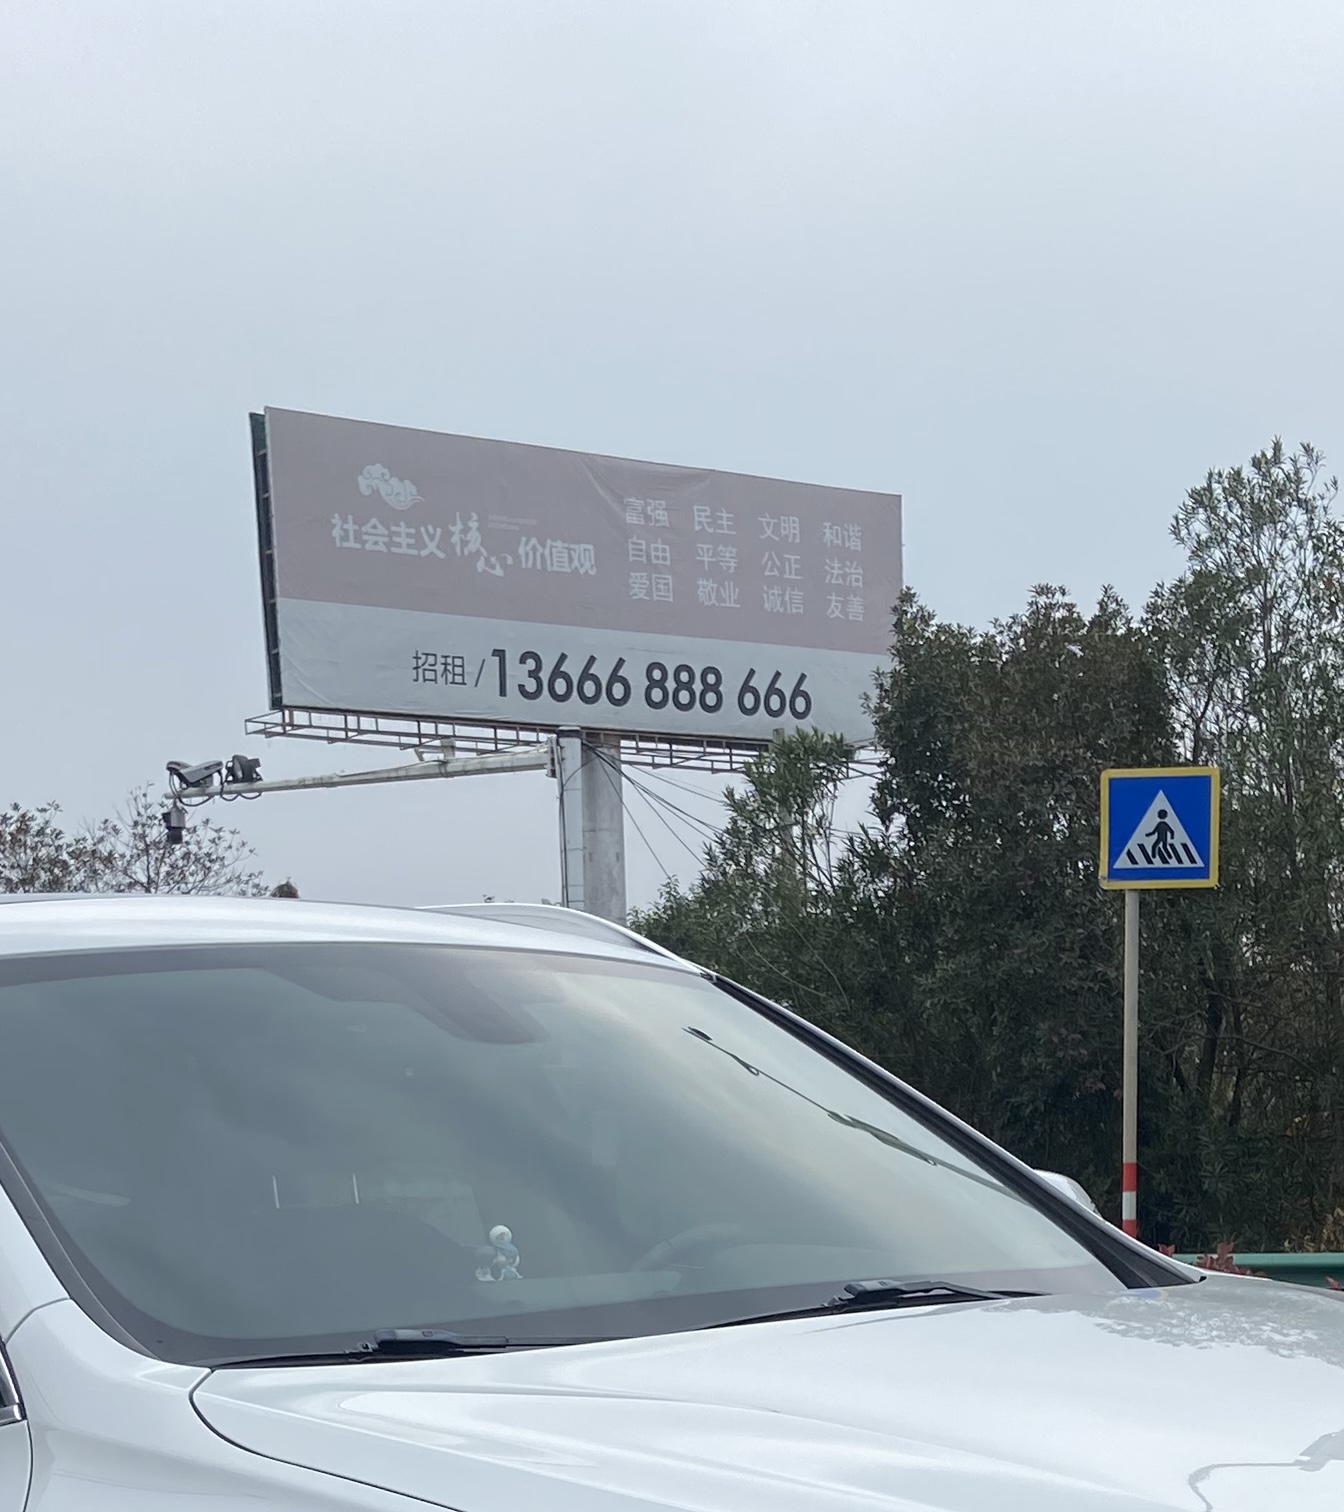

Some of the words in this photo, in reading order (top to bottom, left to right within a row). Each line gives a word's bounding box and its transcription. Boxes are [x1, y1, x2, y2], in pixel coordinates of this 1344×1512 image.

[331, 511, 597, 577] 社会主义核心价值观
[623, 497, 671, 528] 富强
[693, 504, 737, 535] 民主
[758, 512, 801, 544] 文明
[822, 521, 862, 552] 和谐
[627, 535, 671, 566] 自由
[695, 543, 739, 574] 平等
[761, 551, 804, 580] 公正
[824, 557, 864, 589] 法治
[628, 571, 674, 602] 爱国
[696, 577, 741, 609] 敬业
[762, 584, 804, 615] 诚信
[825, 592, 865, 622] 友善
